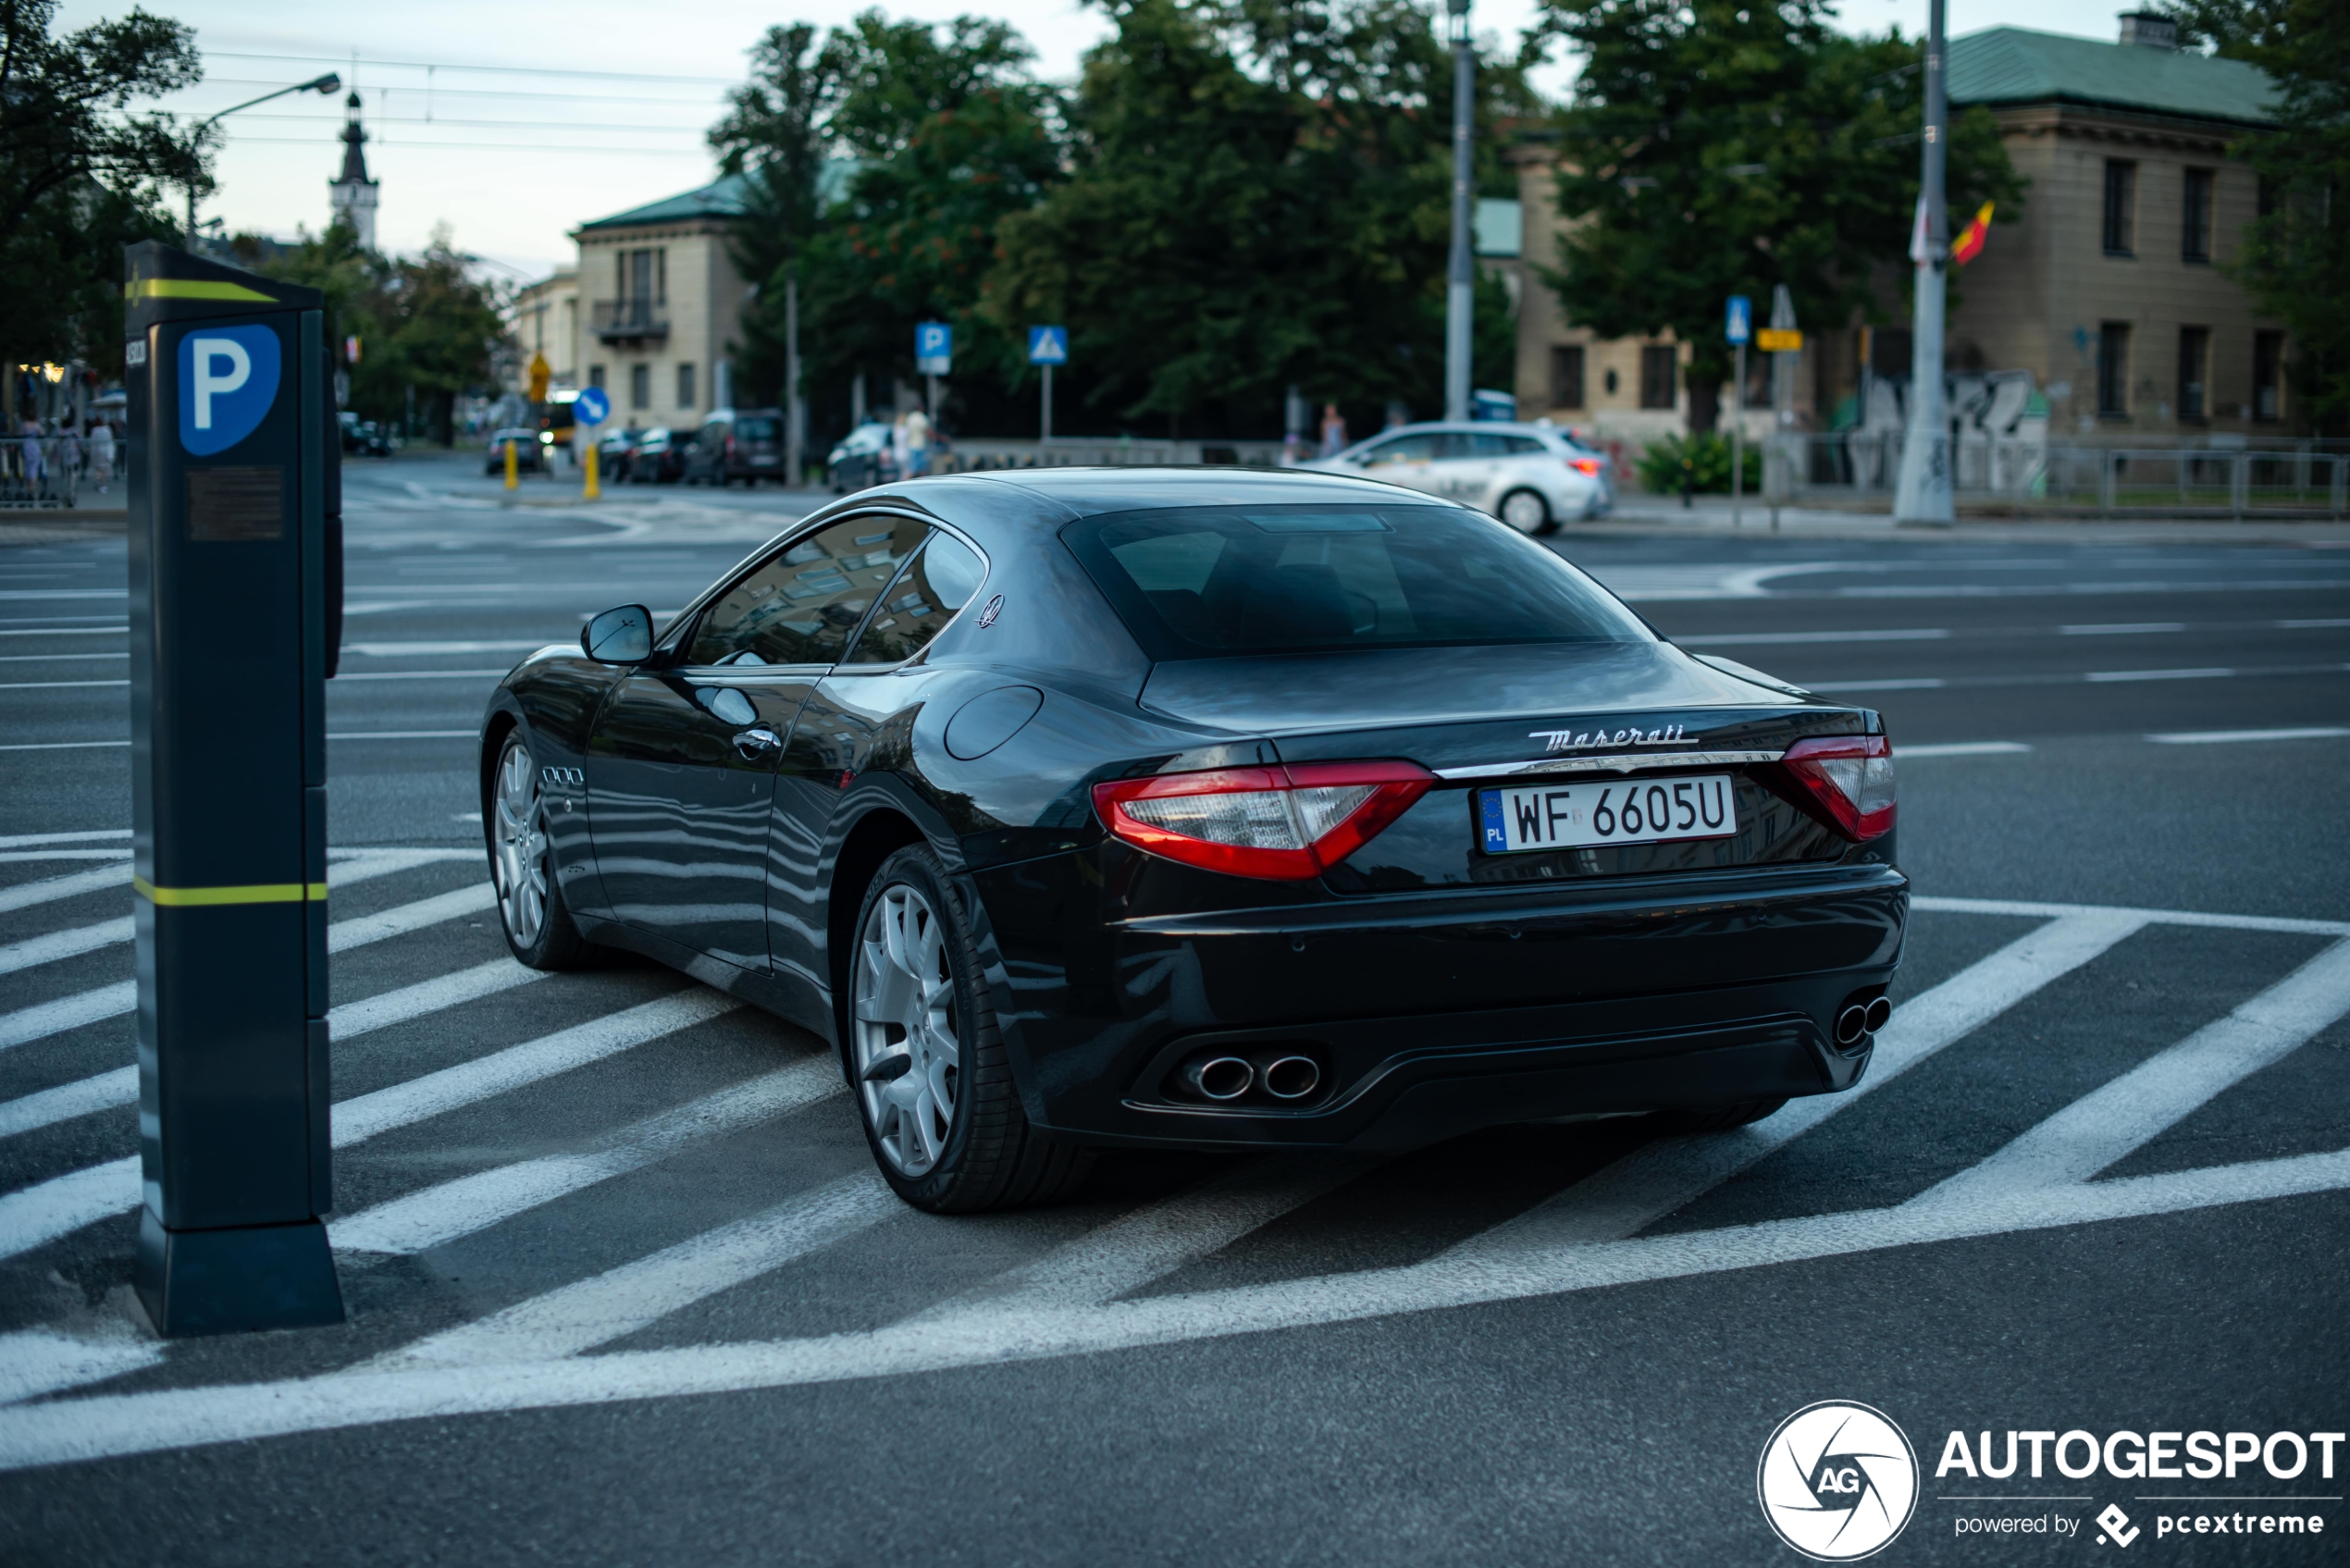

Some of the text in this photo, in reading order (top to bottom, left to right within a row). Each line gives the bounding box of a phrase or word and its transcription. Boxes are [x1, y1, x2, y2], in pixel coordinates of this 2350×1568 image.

[925, 327, 944, 352] P
[193, 339, 251, 429] P
[1528, 724, 1700, 751] Maserati
[1514, 781, 1725, 844] WF 6605U
[1487, 828, 1503, 842] PL
